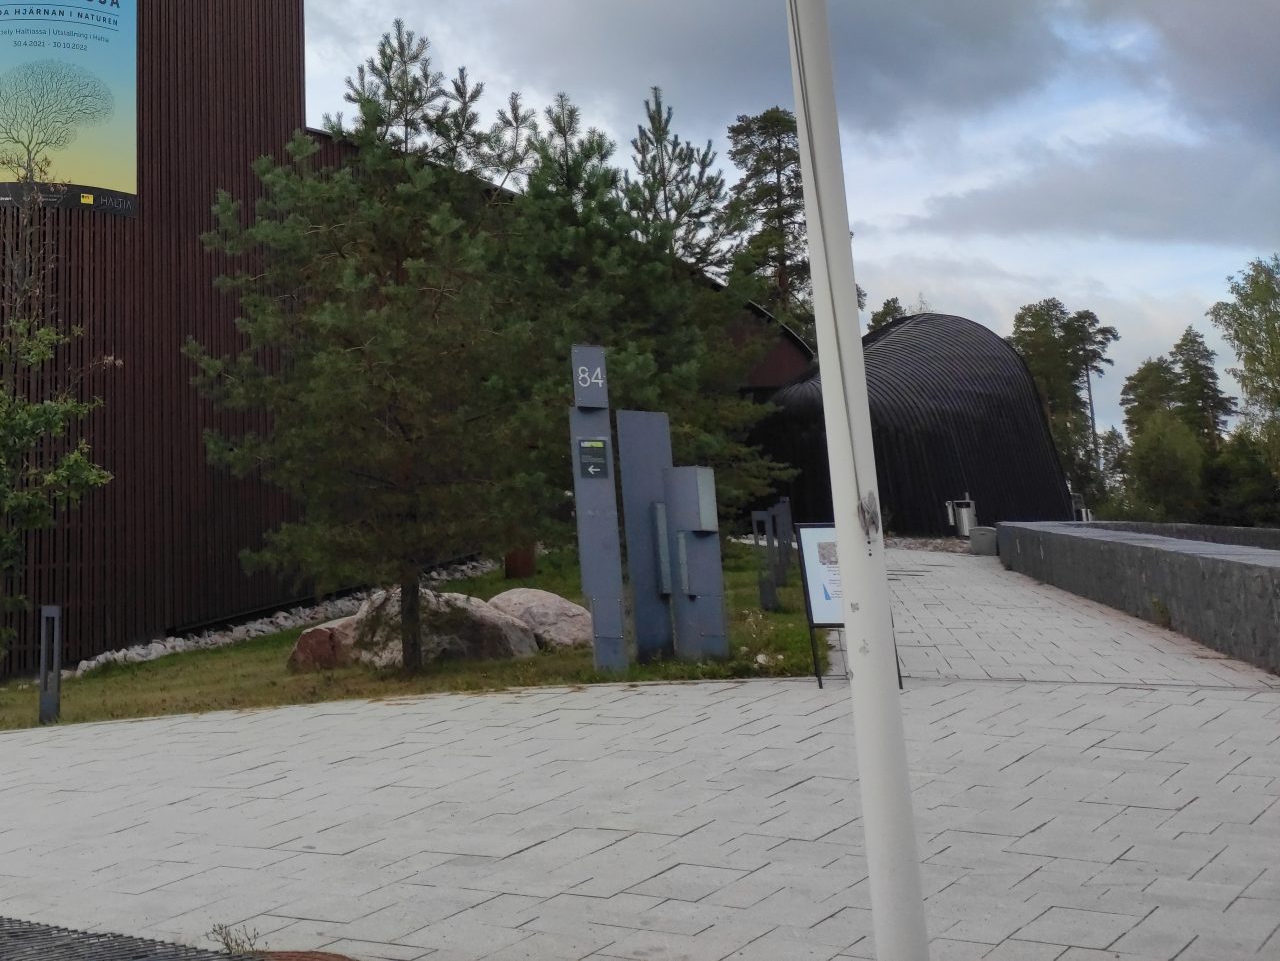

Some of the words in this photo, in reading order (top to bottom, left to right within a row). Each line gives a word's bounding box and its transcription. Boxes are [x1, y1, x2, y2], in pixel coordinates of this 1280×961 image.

[14, 6, 65, 17] HJÄRNAN
[77, 12, 118, 27] NATUREN
[100, 195, 132, 210] HALTIA
[578, 366, 604, 388] 84
